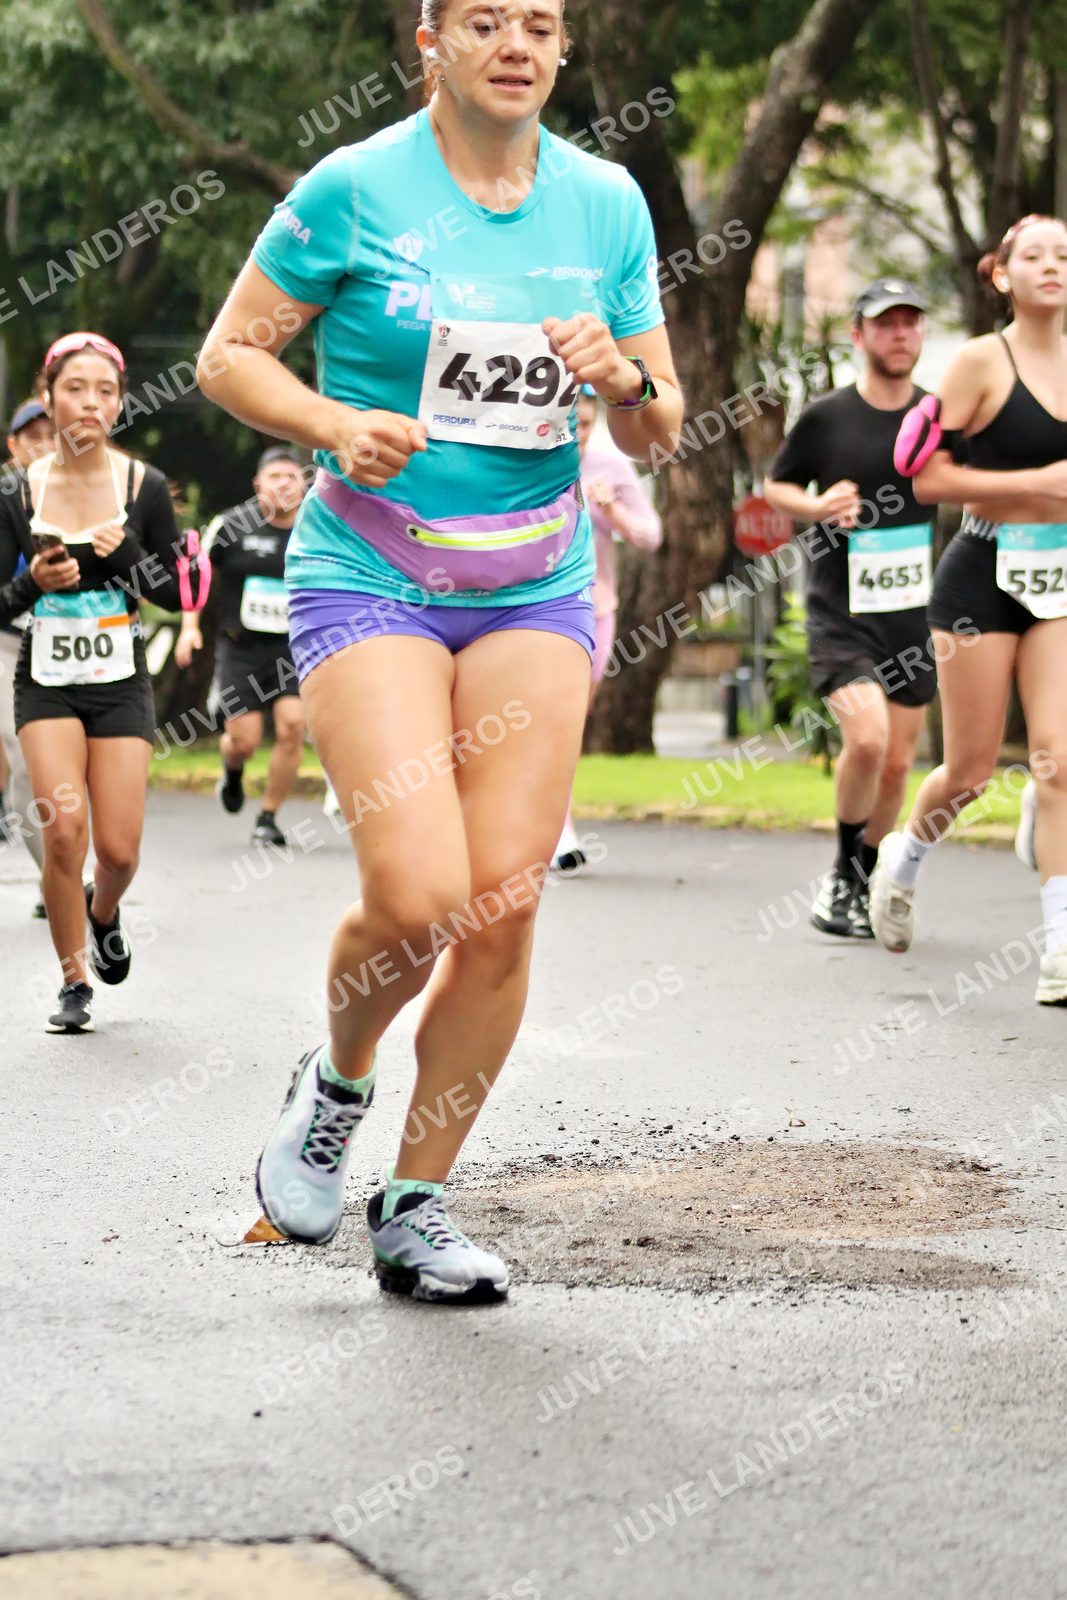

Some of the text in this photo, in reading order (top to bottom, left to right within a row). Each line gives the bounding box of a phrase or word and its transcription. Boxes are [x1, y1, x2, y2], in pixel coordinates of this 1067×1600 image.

[433, 414, 477, 427] PERDURA
[498, 423, 529, 433] BROOKS
[736, 511, 790, 539] ALTO
[857, 562, 922, 590] 4653
[1007, 567, 1067, 596] 552
[51, 632, 114, 662] 500
